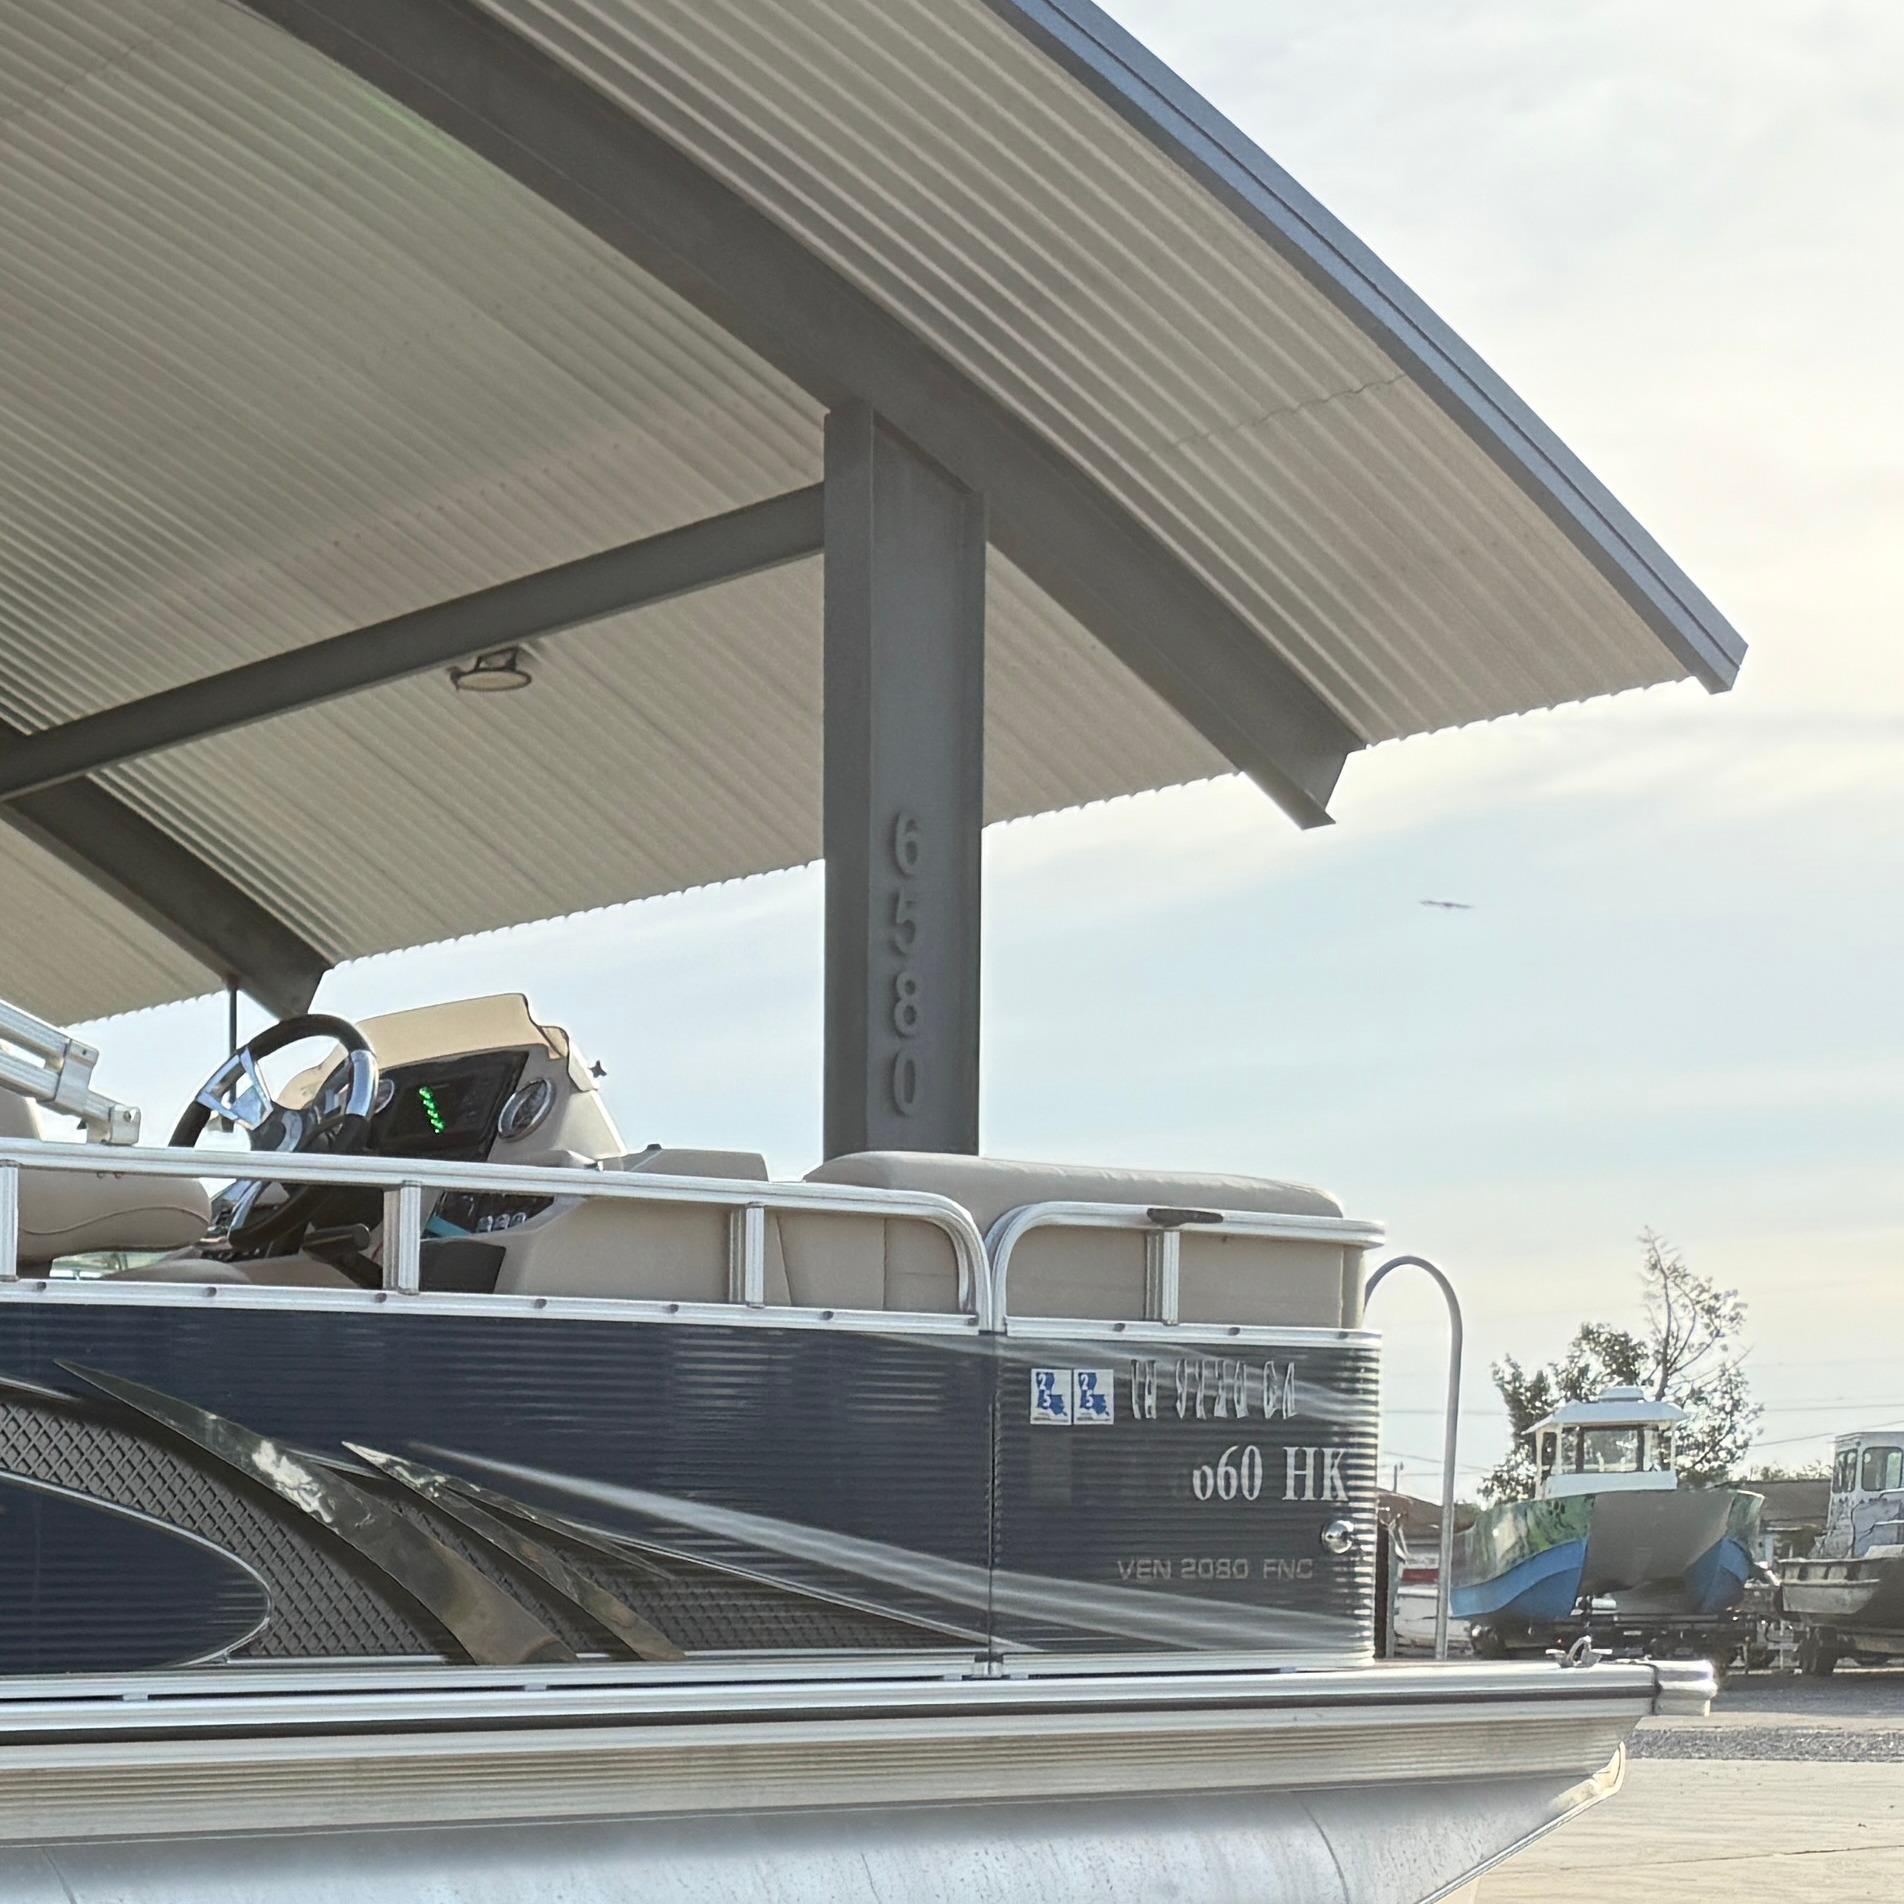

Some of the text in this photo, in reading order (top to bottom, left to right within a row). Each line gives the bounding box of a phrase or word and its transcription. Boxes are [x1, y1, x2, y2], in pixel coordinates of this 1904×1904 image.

[892, 809, 926, 1117] 6580
[1282, 1446, 1350, 1501] HK
[1117, 1557, 1313, 1582] VEN 2080 FNC
